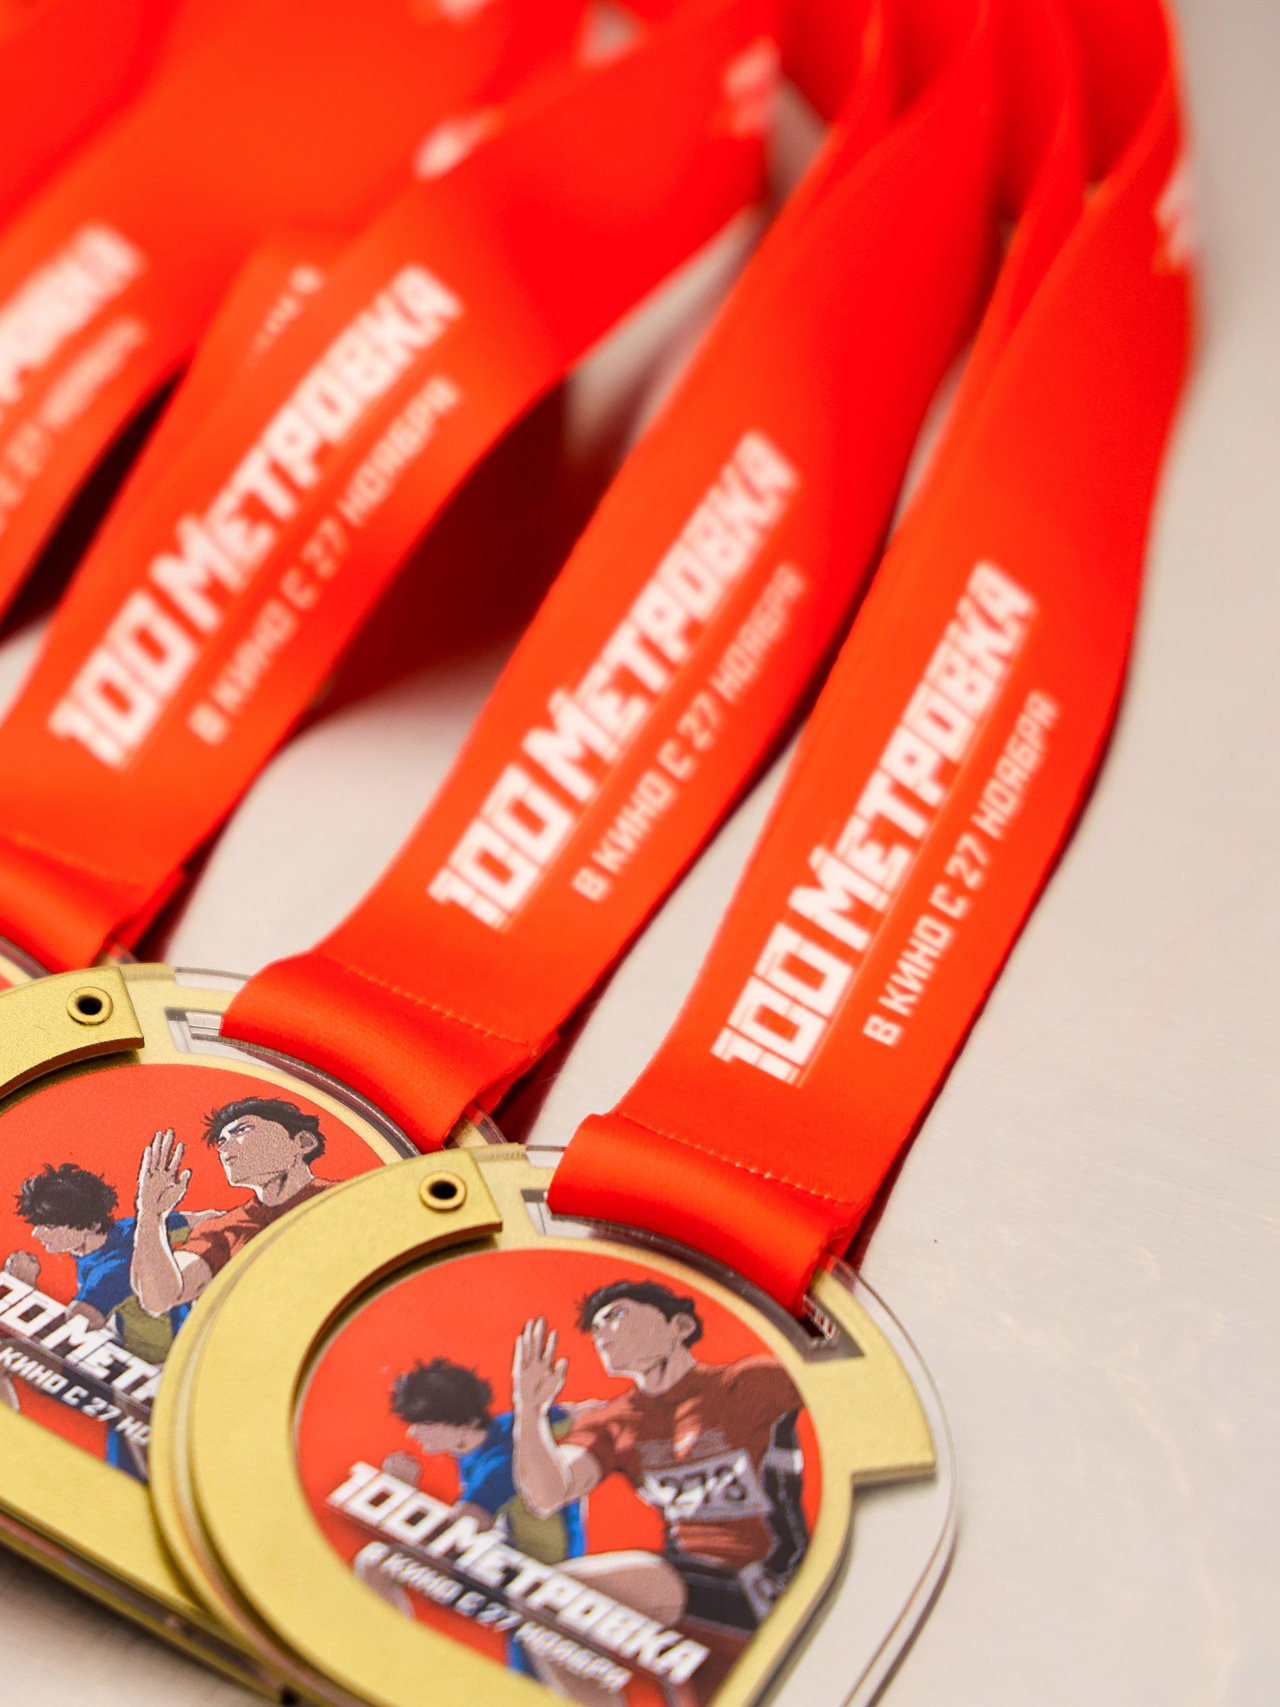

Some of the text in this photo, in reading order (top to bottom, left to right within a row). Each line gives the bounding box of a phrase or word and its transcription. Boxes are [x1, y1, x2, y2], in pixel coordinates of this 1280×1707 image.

[48, 588, 198, 769] 100
[427, 430, 799, 930] 100 МЕТРОВКА
[572, 867, 610, 901] В
[591, 770, 677, 873] КИНО
[657, 739, 696, 780] С
[677, 692, 721, 751] 27
[710, 561, 1036, 1085] 100 МЕТРОВКА
[863, 689, 1060, 1046] В КИНО С 27 НОЯБРЯ
[62, 1385, 89, 1406] С
[82, 1397, 122, 1422] 27
[325, 1461, 709, 1684] 100 МЕТРОВКА
